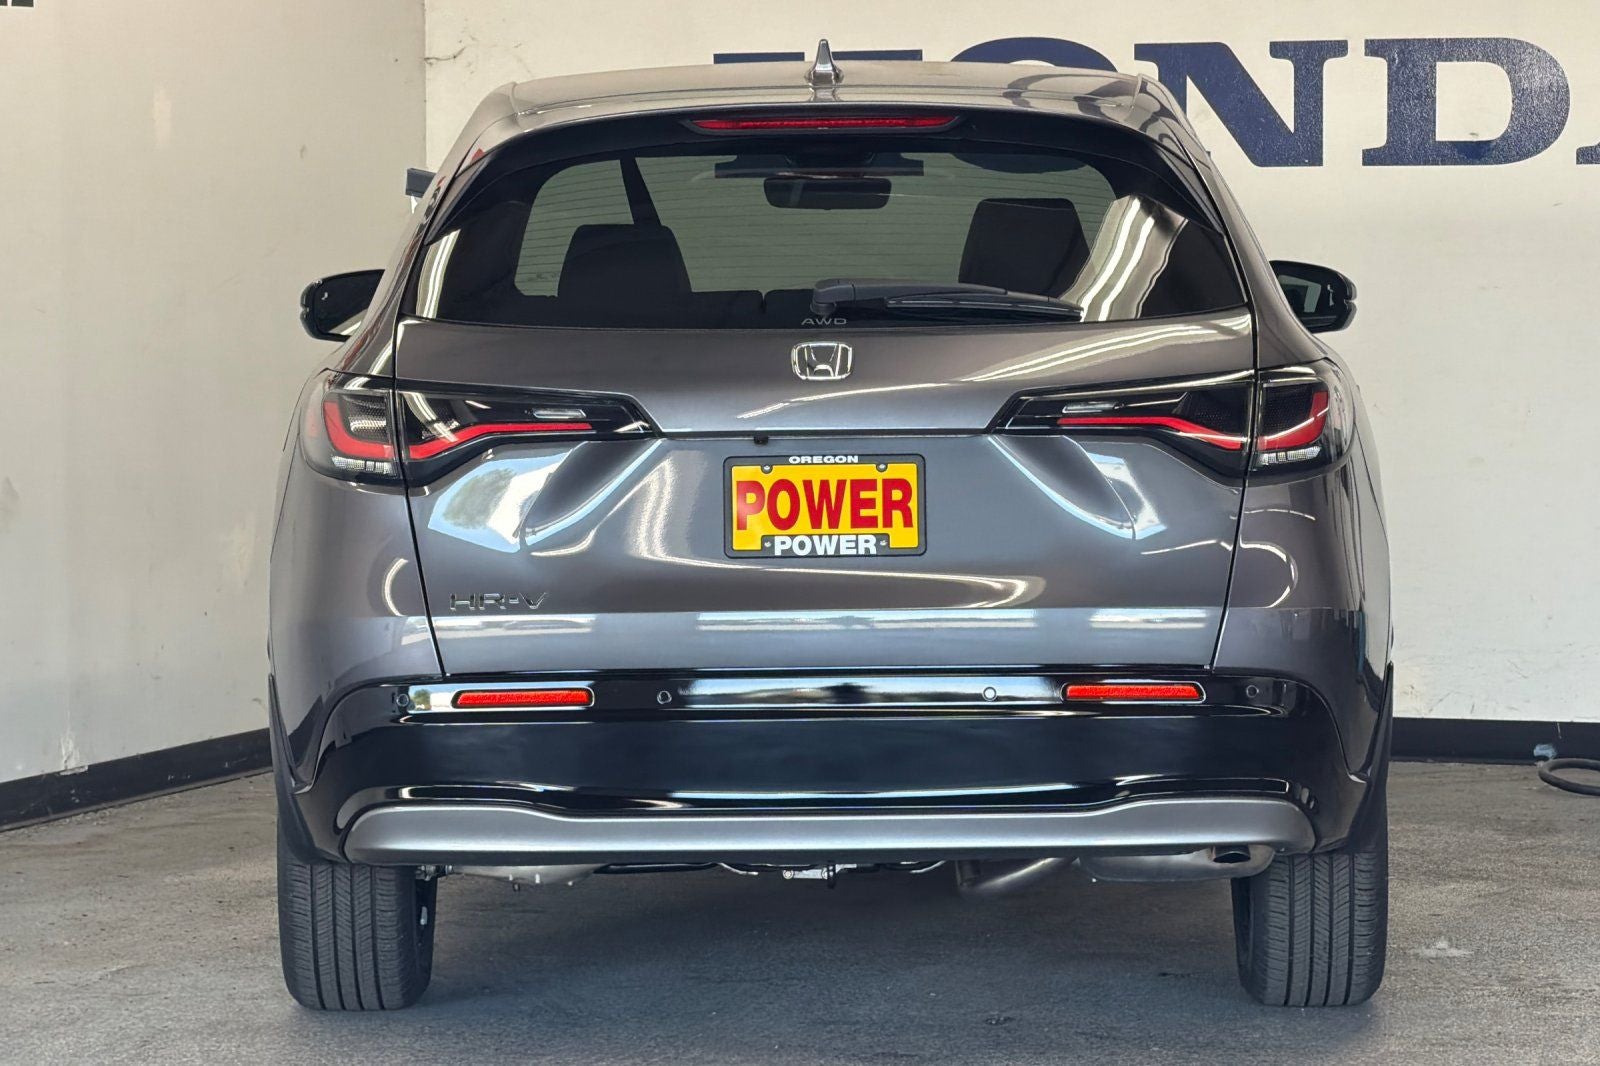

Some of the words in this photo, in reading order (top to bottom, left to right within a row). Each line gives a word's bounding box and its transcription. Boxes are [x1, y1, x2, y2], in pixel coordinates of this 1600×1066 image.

[801, 317, 847, 326] AWD
[788, 455, 859, 464] OREGON
[736, 478, 914, 530] POWER
[774, 535, 877, 556] POWER
[450, 592, 548, 611] HR-V
